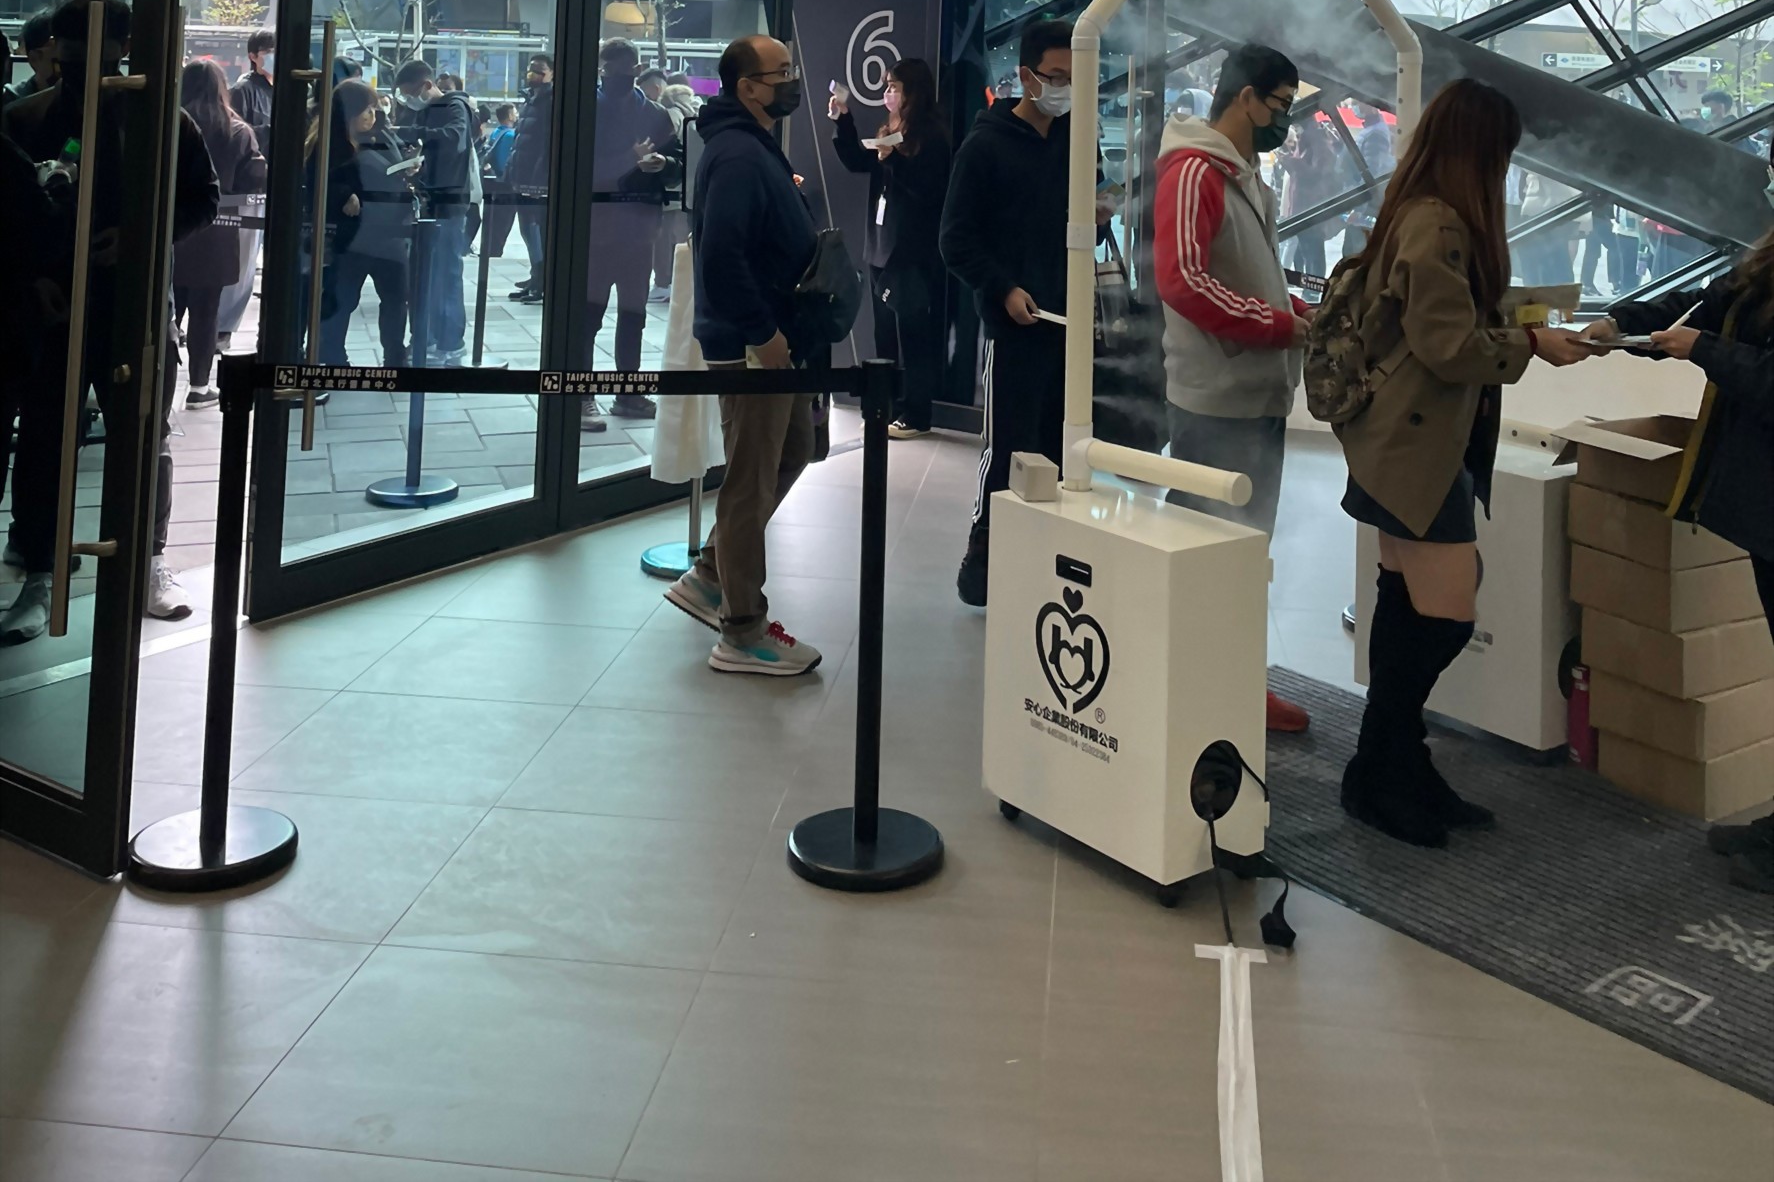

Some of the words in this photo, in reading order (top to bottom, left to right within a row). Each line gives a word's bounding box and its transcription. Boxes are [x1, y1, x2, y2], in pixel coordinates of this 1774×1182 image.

[846, 10, 902, 107] 6
[302, 367, 331, 377] TAIPEI
[333, 368, 362, 378] MUSIC
[365, 369, 398, 379] CENTER
[566, 373, 594, 382] TAIPEI
[597, 373, 625, 382] MUSIC
[627, 373, 660, 383] CENTER
